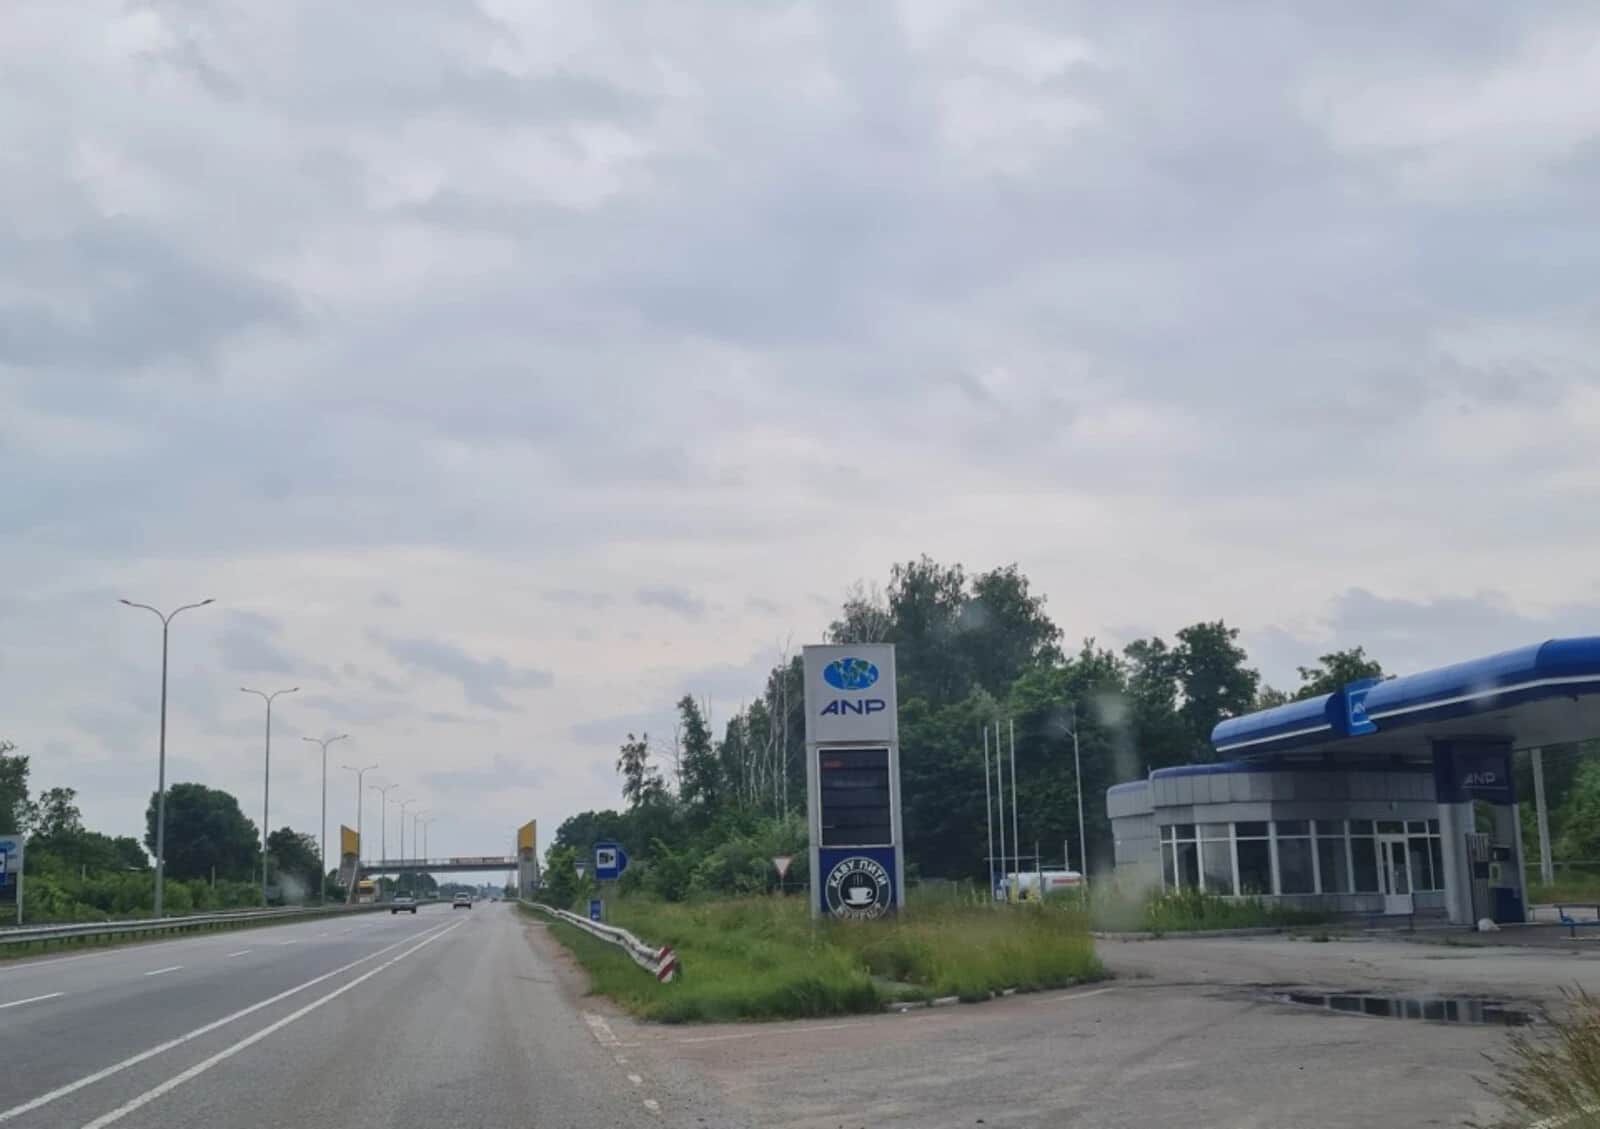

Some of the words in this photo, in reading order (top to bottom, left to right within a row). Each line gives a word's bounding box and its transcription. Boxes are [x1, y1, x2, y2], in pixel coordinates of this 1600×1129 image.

[821, 699, 886, 716] ANP
[1463, 771, 1496, 785] ANP
[829, 860, 855, 888] КАВУ
